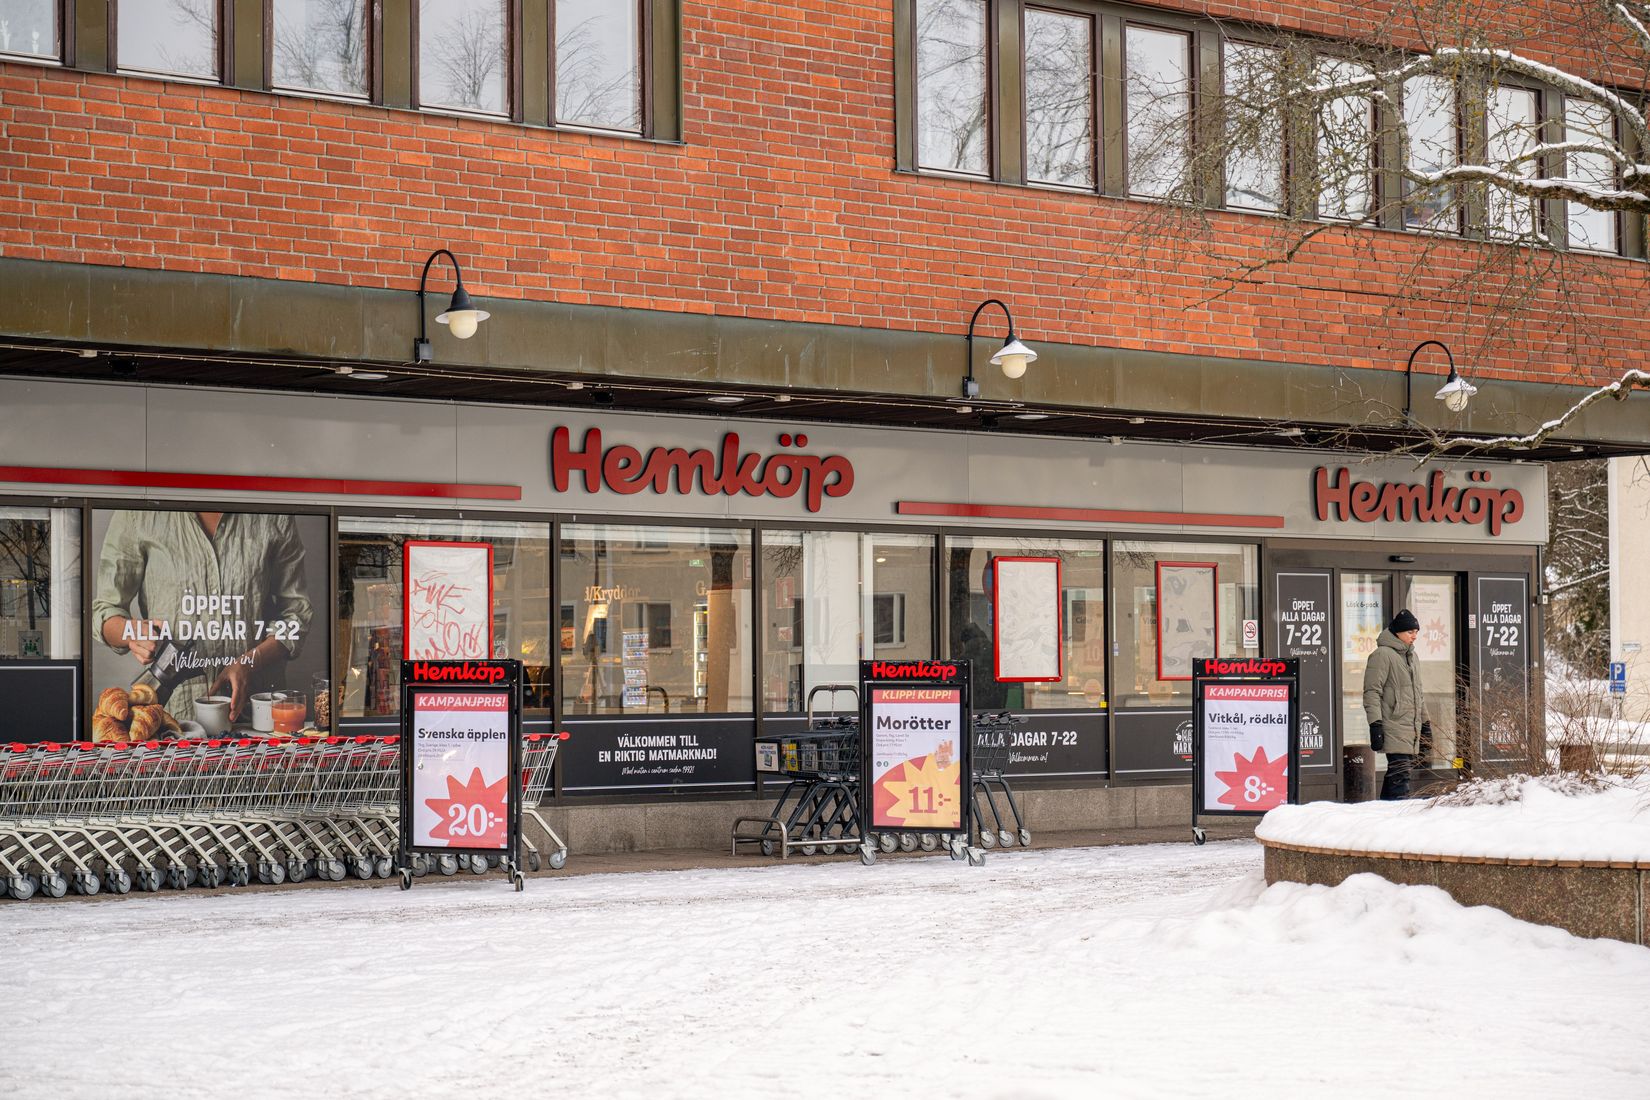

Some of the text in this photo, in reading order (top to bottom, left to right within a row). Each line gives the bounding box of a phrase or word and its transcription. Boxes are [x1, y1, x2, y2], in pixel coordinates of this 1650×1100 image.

[551, 425, 855, 513] Hemköp
[1315, 466, 1525, 537] Hemköp
[181, 588, 245, 616] ÖPPET
[1292, 598, 1315, 611] ÖPPET
[1491, 600, 1512, 613] ÖPPET
[1281, 611, 1326, 622] ALLA DAGAR
[1482, 613, 1498, 624] ALLA
[1499, 614, 1522, 625] DAGAR
[121, 619, 300, 641] ALLA DAGAR 7-22
[1286, 624, 1322, 646] 7-22
[1486, 626, 1519, 646] 7-22
[169, 648, 257, 673] Välkommen in!
[1204, 658, 1286, 677] Hemköp
[413, 661, 505, 685] Hemköp
[872, 661, 957, 681] Hemköp
[1614, 664, 1622, 680] P
[881, 690, 952, 700] KLIPP! KLIPP!
[1208, 687, 1287, 698] KAMPANJPRIS!
[418, 695, 507, 708] KAMPANJPRIS!
[876, 715, 951, 730] Morötter
[1208, 712, 1247, 726] Vitkål,
[1249, 713, 1287, 725] rödkål
[417, 727, 506, 742] Svenska äpplen
[617, 733, 699, 748] VÄLKOMMEN TILL
[1010, 731, 1047, 747] DAGAR
[1051, 731, 1078, 746] 7-22
[1300, 735, 1323, 749] RKNAD
[598, 748, 717, 763] EN RIKTIG MATMARKNAD!
[1173, 741, 1192, 754] MARK
[1244, 775, 1275, 803] 8:-
[908, 786, 952, 814] 11:-
[448, 803, 504, 837] 20:-
